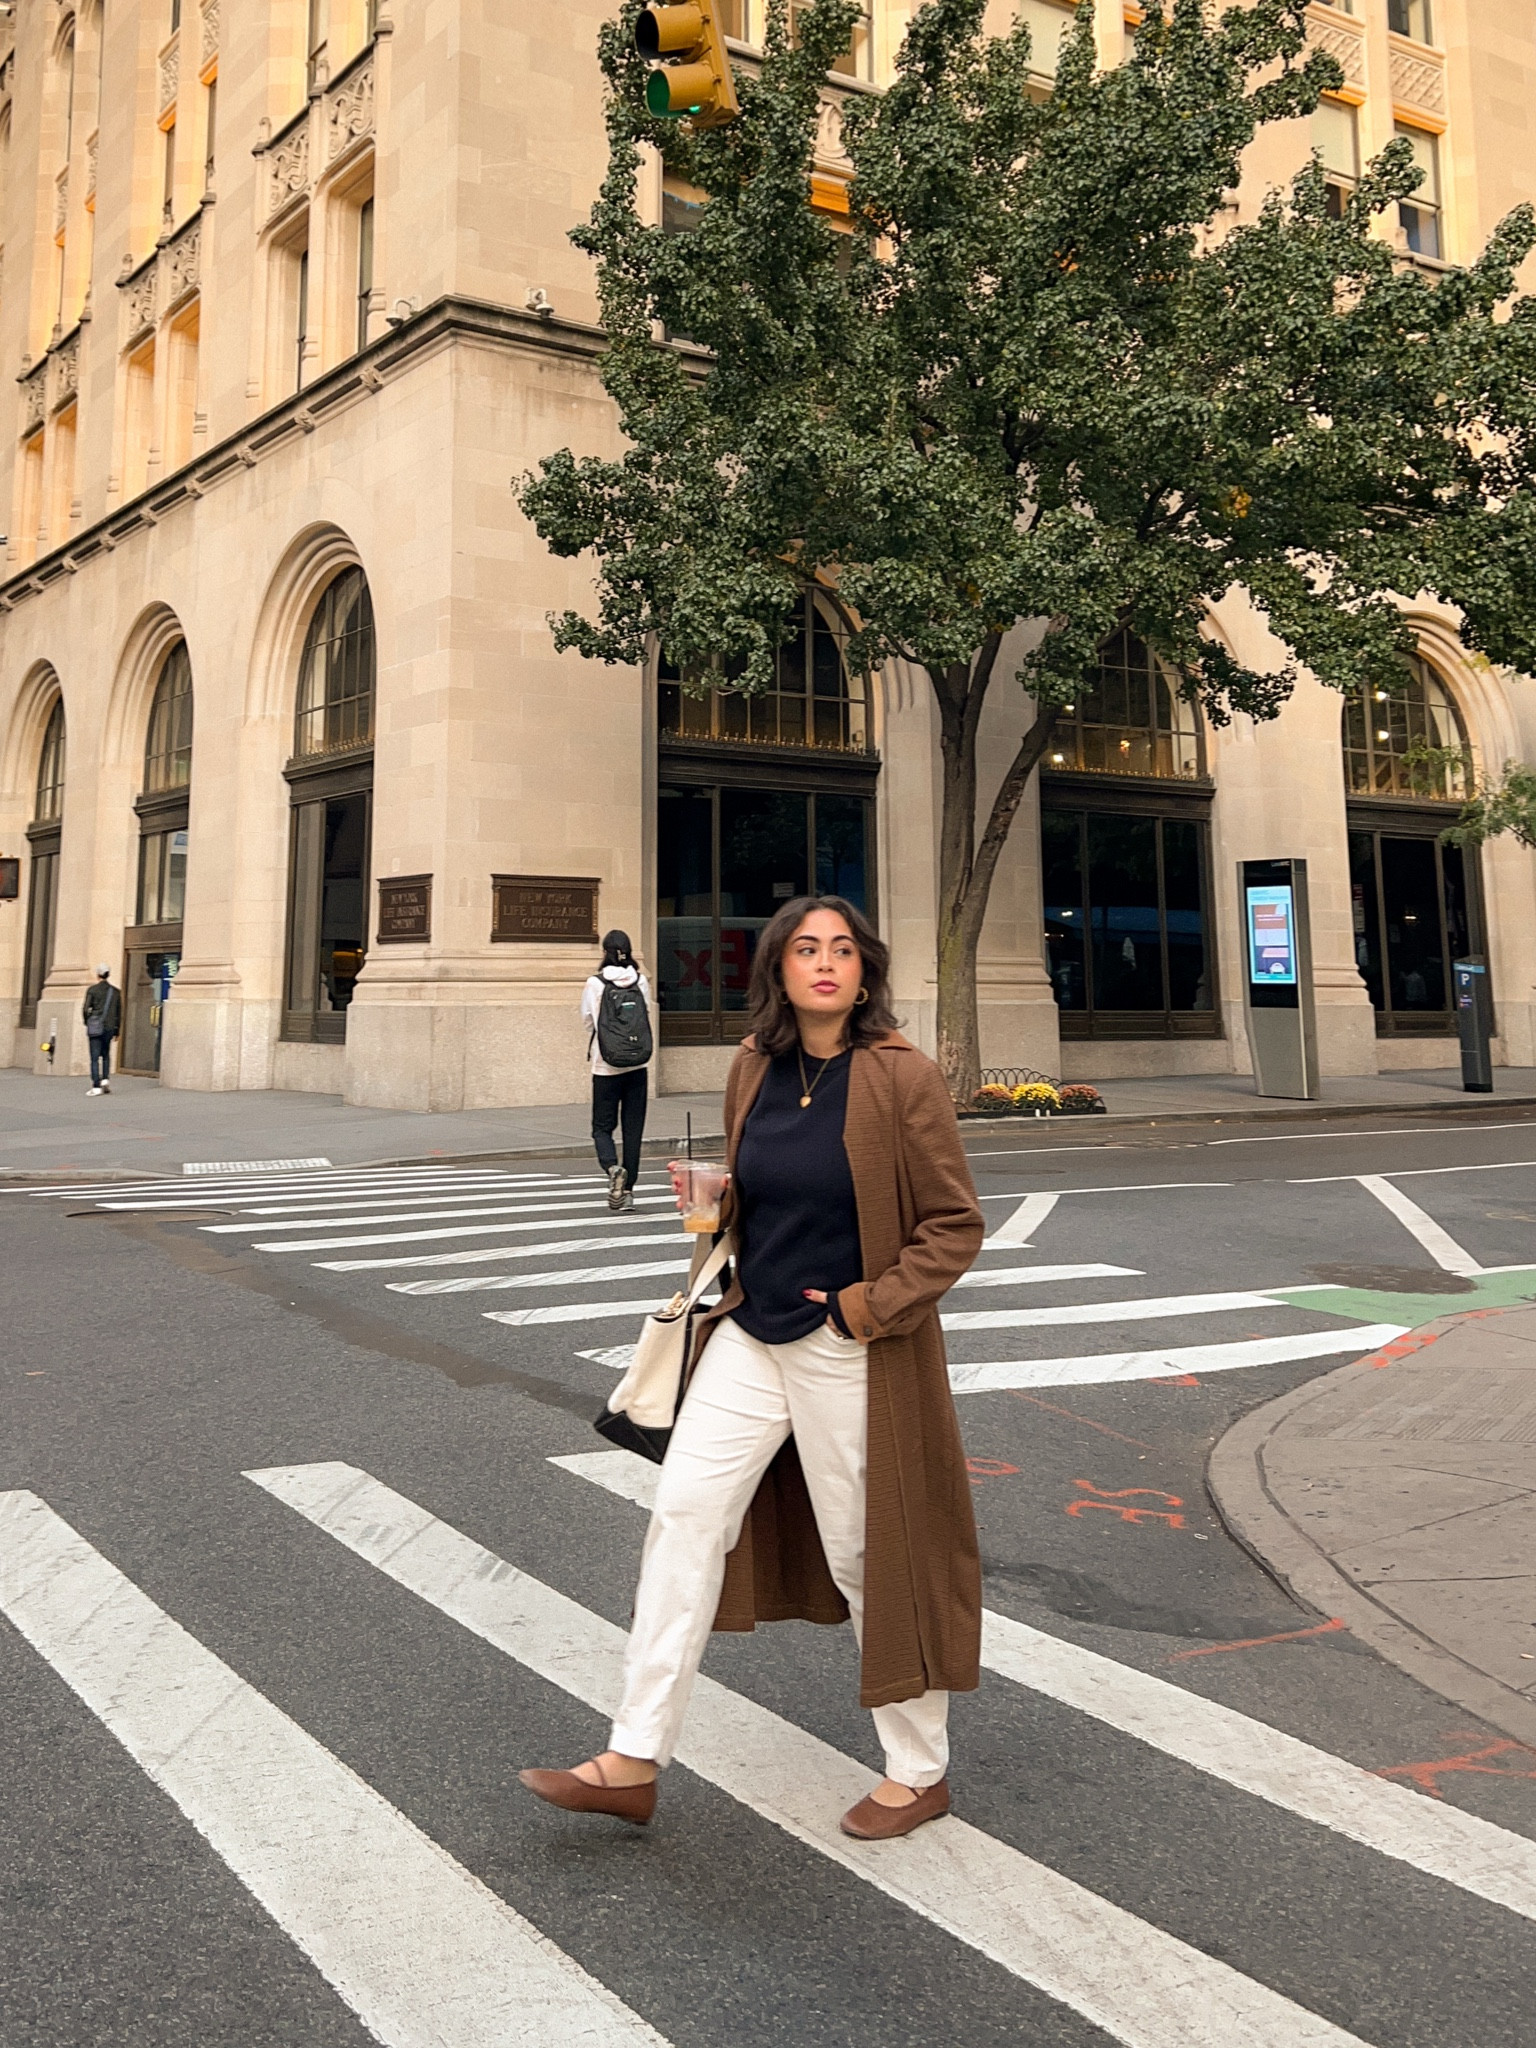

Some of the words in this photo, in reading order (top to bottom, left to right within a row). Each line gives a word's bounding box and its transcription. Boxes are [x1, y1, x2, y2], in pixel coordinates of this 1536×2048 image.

[502, 904, 528, 916] LIFE
[521, 918, 570, 929] COMPANY
[1461, 973, 1471, 986] P
